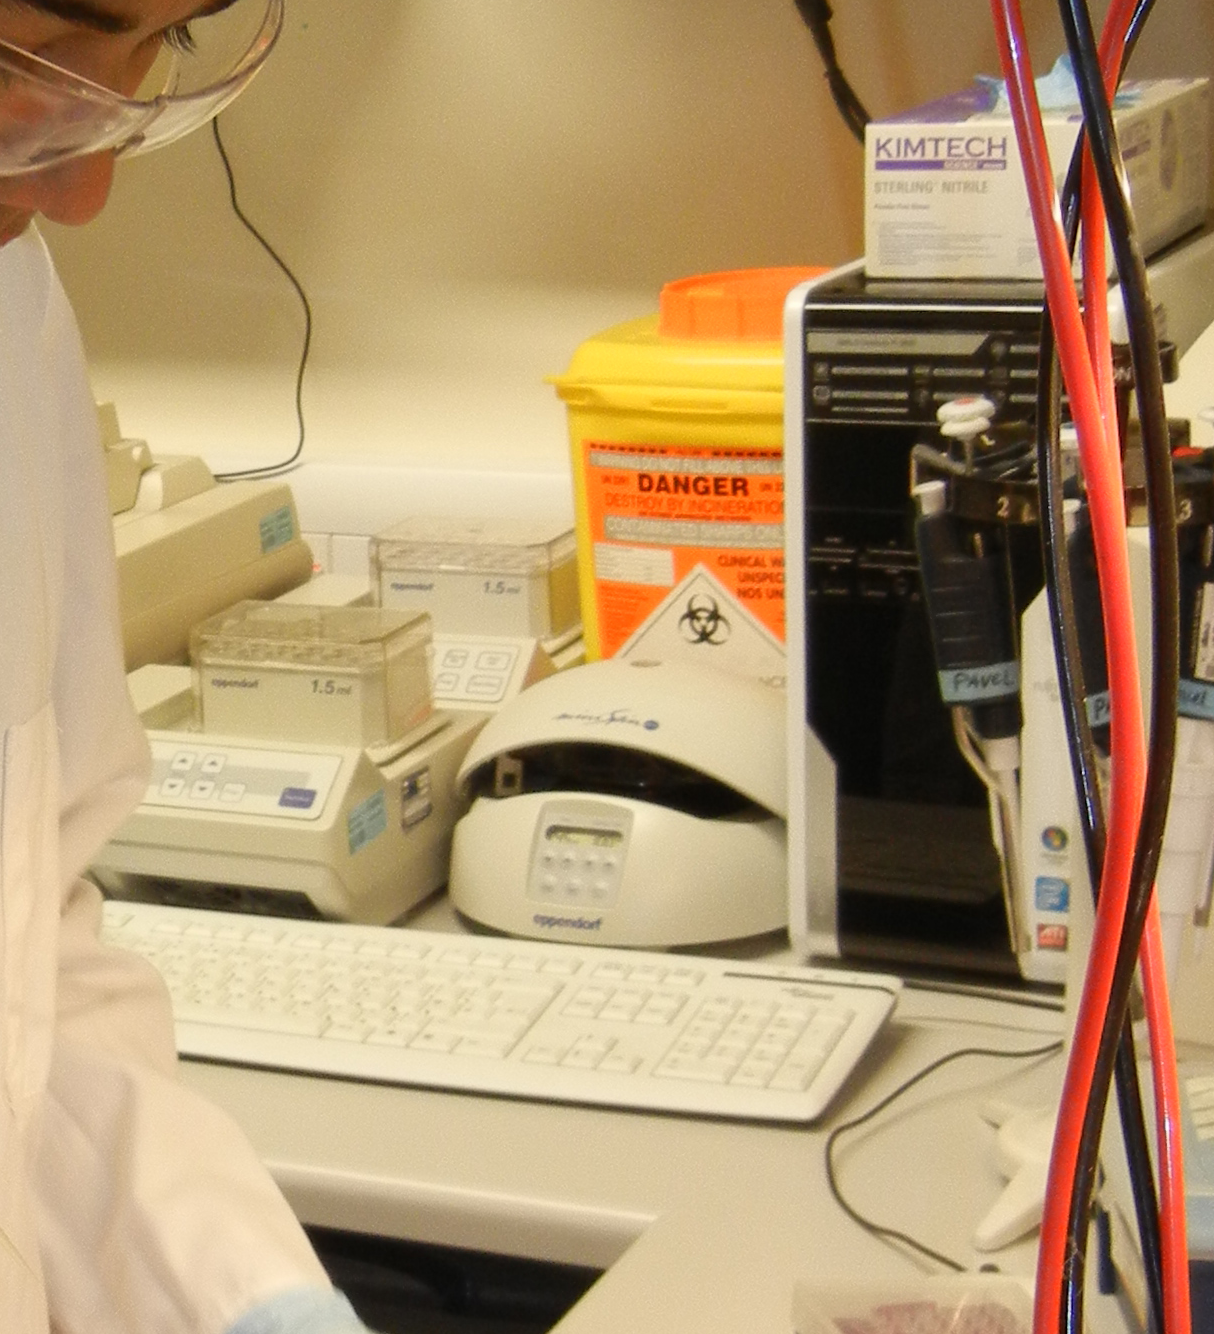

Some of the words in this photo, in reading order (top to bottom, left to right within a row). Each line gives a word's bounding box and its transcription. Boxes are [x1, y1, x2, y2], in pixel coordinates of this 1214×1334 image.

[875, 137, 1008, 158] KIMTECH
[873, 180, 934, 195] STERLING
[941, 180, 989, 195] NITRILE
[637, 473, 750, 497] DANGER
[605, 492, 665, 511] DESTROY
[667, 496, 685, 511] BY
[688, 498, 784, 515] INCINERATIO
[717, 554, 767, 568] CLINICAL
[736, 570, 784, 583] UNSPEC
[484, 581, 505, 595] 1.5
[211, 676, 260, 689] eppendorf
[311, 678, 336, 694] 1.5
[533, 913, 603, 932] eppendorf
